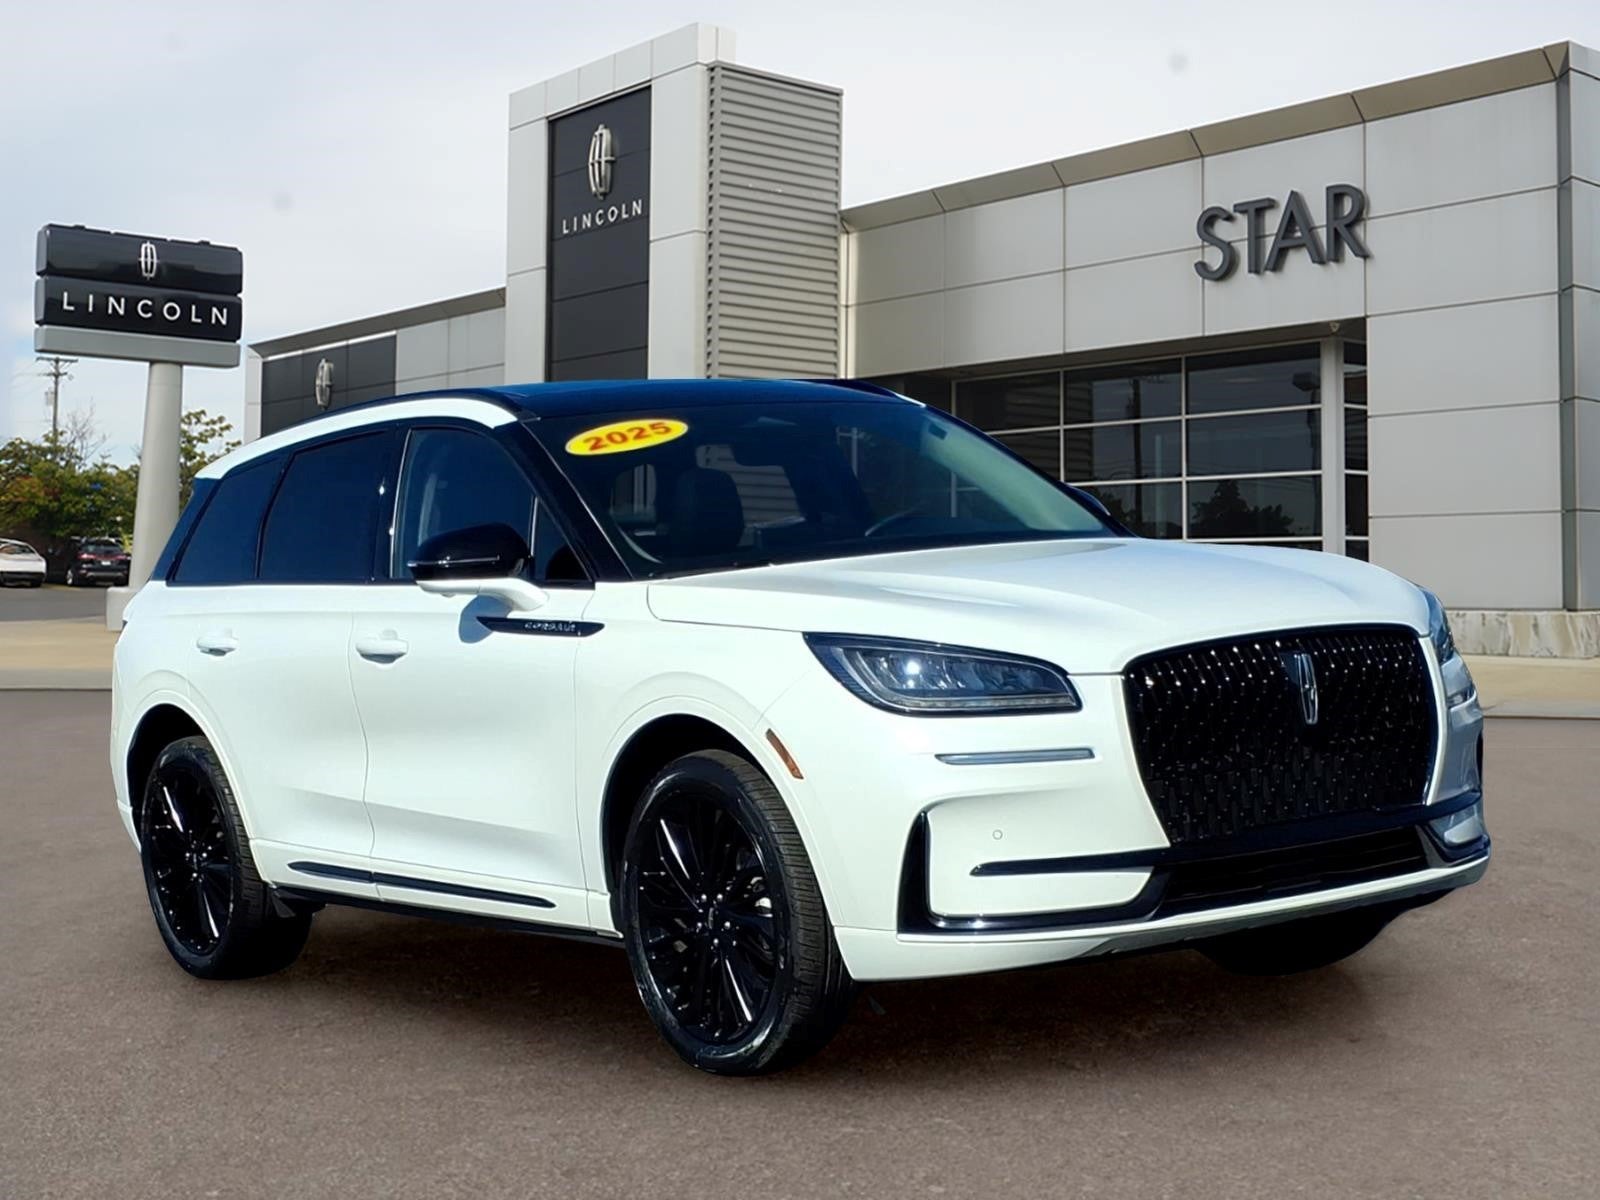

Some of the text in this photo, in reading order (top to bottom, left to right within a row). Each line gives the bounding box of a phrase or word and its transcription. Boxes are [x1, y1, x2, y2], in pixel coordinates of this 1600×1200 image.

[562, 199, 642, 234] LINCOLN
[1194, 184, 1371, 281] STAR
[62, 291, 228, 325] LINCOLN
[583, 422, 672, 451] 2025
